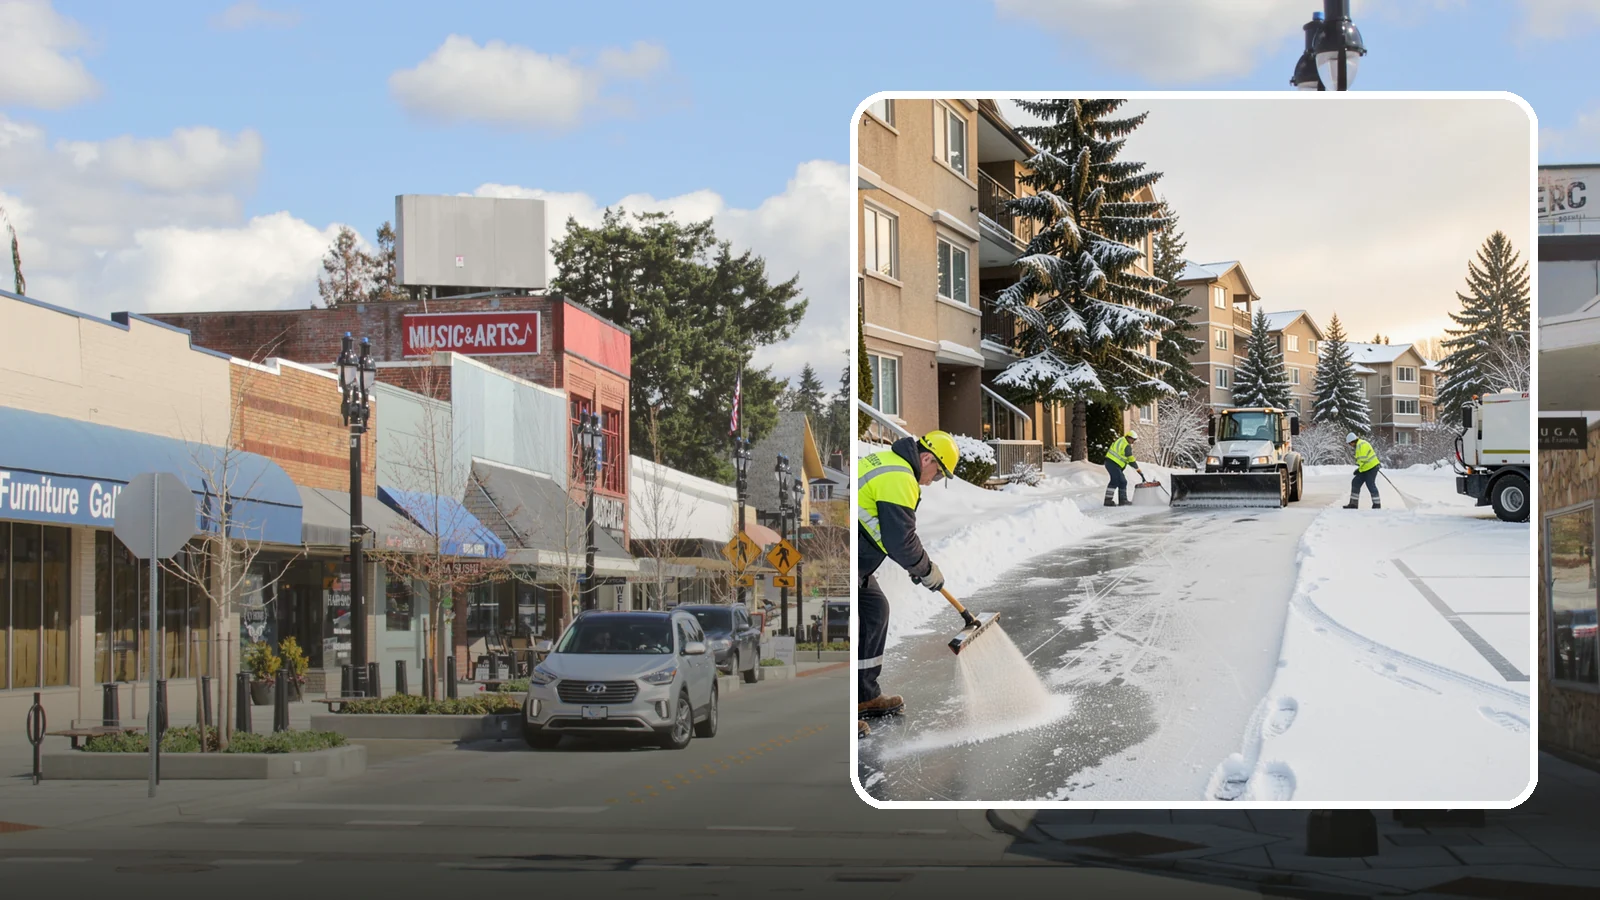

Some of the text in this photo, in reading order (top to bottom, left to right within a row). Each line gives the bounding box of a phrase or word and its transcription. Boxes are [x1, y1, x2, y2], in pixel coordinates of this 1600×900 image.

[0, 471, 121, 518] Furniture Gal
[453, 563, 479, 574] SUSHI
